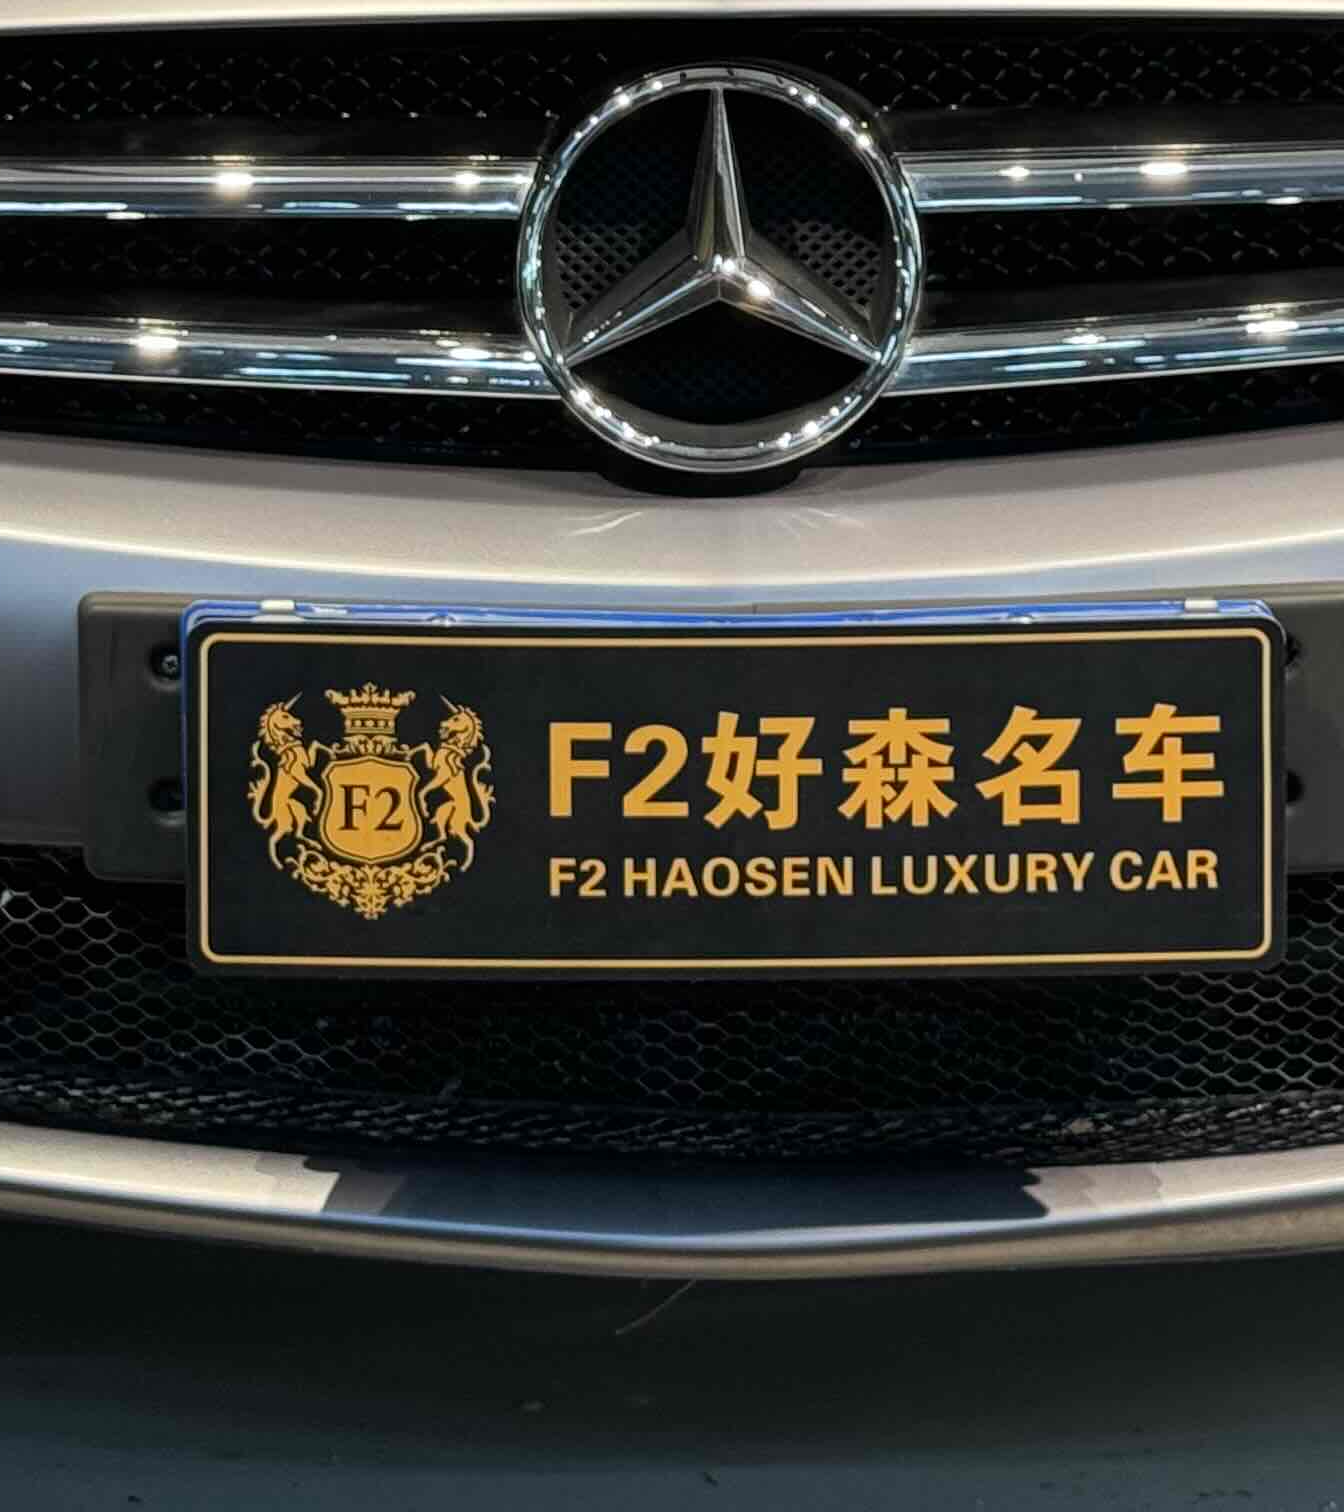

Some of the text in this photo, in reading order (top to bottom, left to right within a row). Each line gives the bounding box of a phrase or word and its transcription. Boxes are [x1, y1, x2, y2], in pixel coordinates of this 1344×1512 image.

[548, 703, 1226, 831] F2好森名车
[337, 784, 405, 831] F2
[548, 848, 1218, 898] F2 HAOSEN LUXURY CAR
